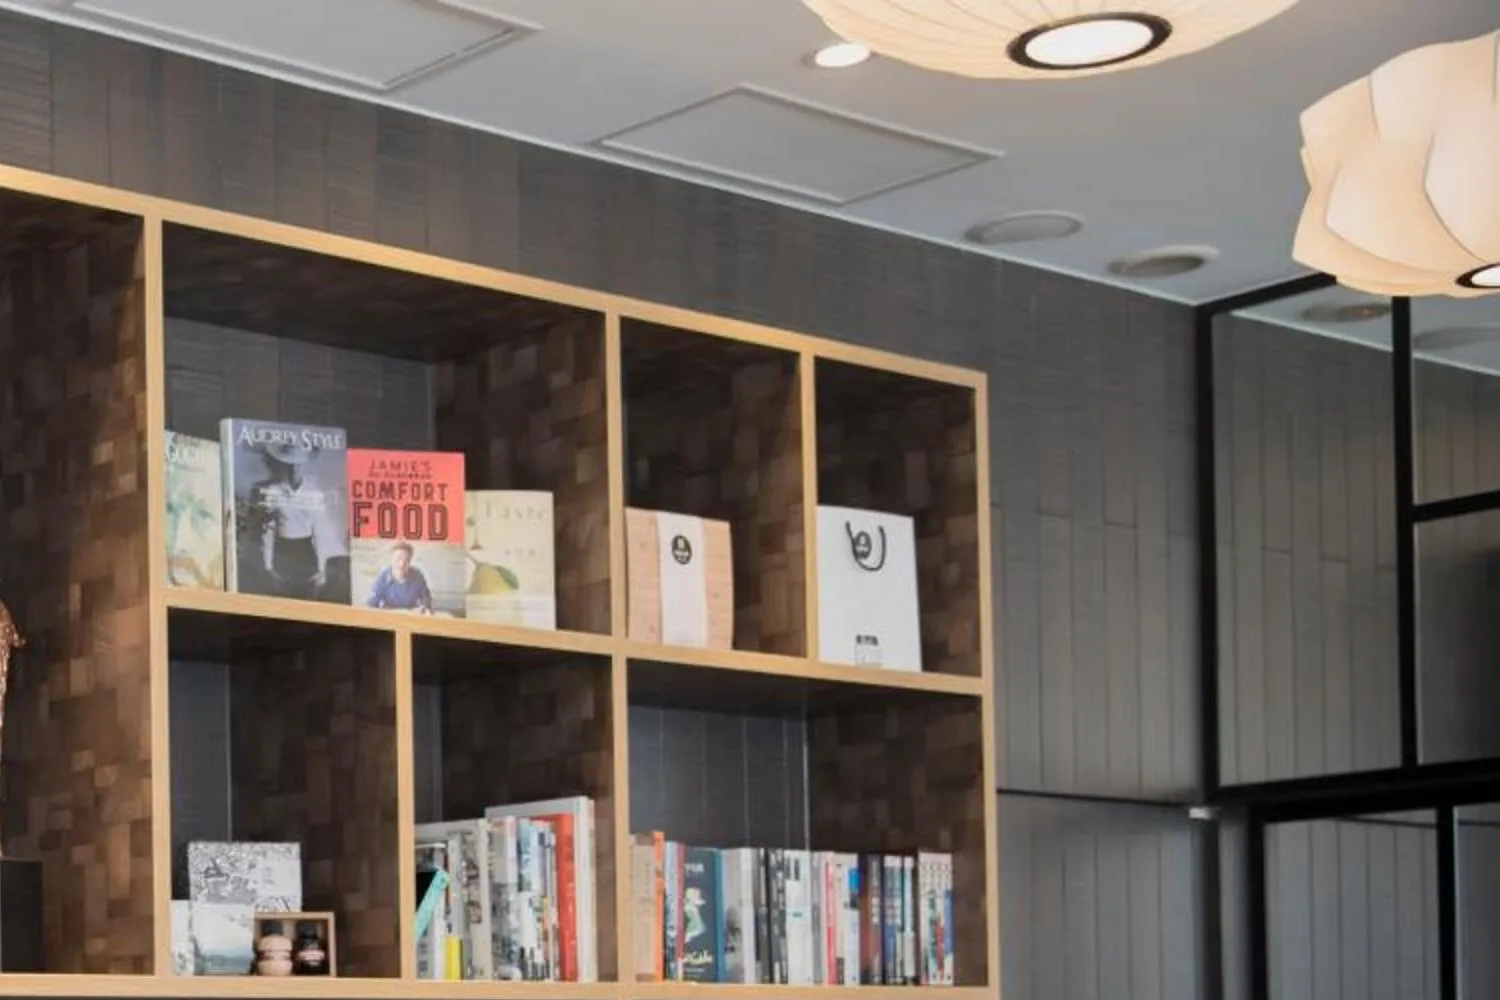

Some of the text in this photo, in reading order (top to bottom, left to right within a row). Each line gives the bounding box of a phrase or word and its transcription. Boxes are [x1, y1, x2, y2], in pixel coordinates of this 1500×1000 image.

[237, 425, 341, 452] AUDREY STYLE
[369, 459, 432, 473] JAMIE'S
[352, 480, 449, 501] COMFORT
[353, 501, 449, 541] FOOD
